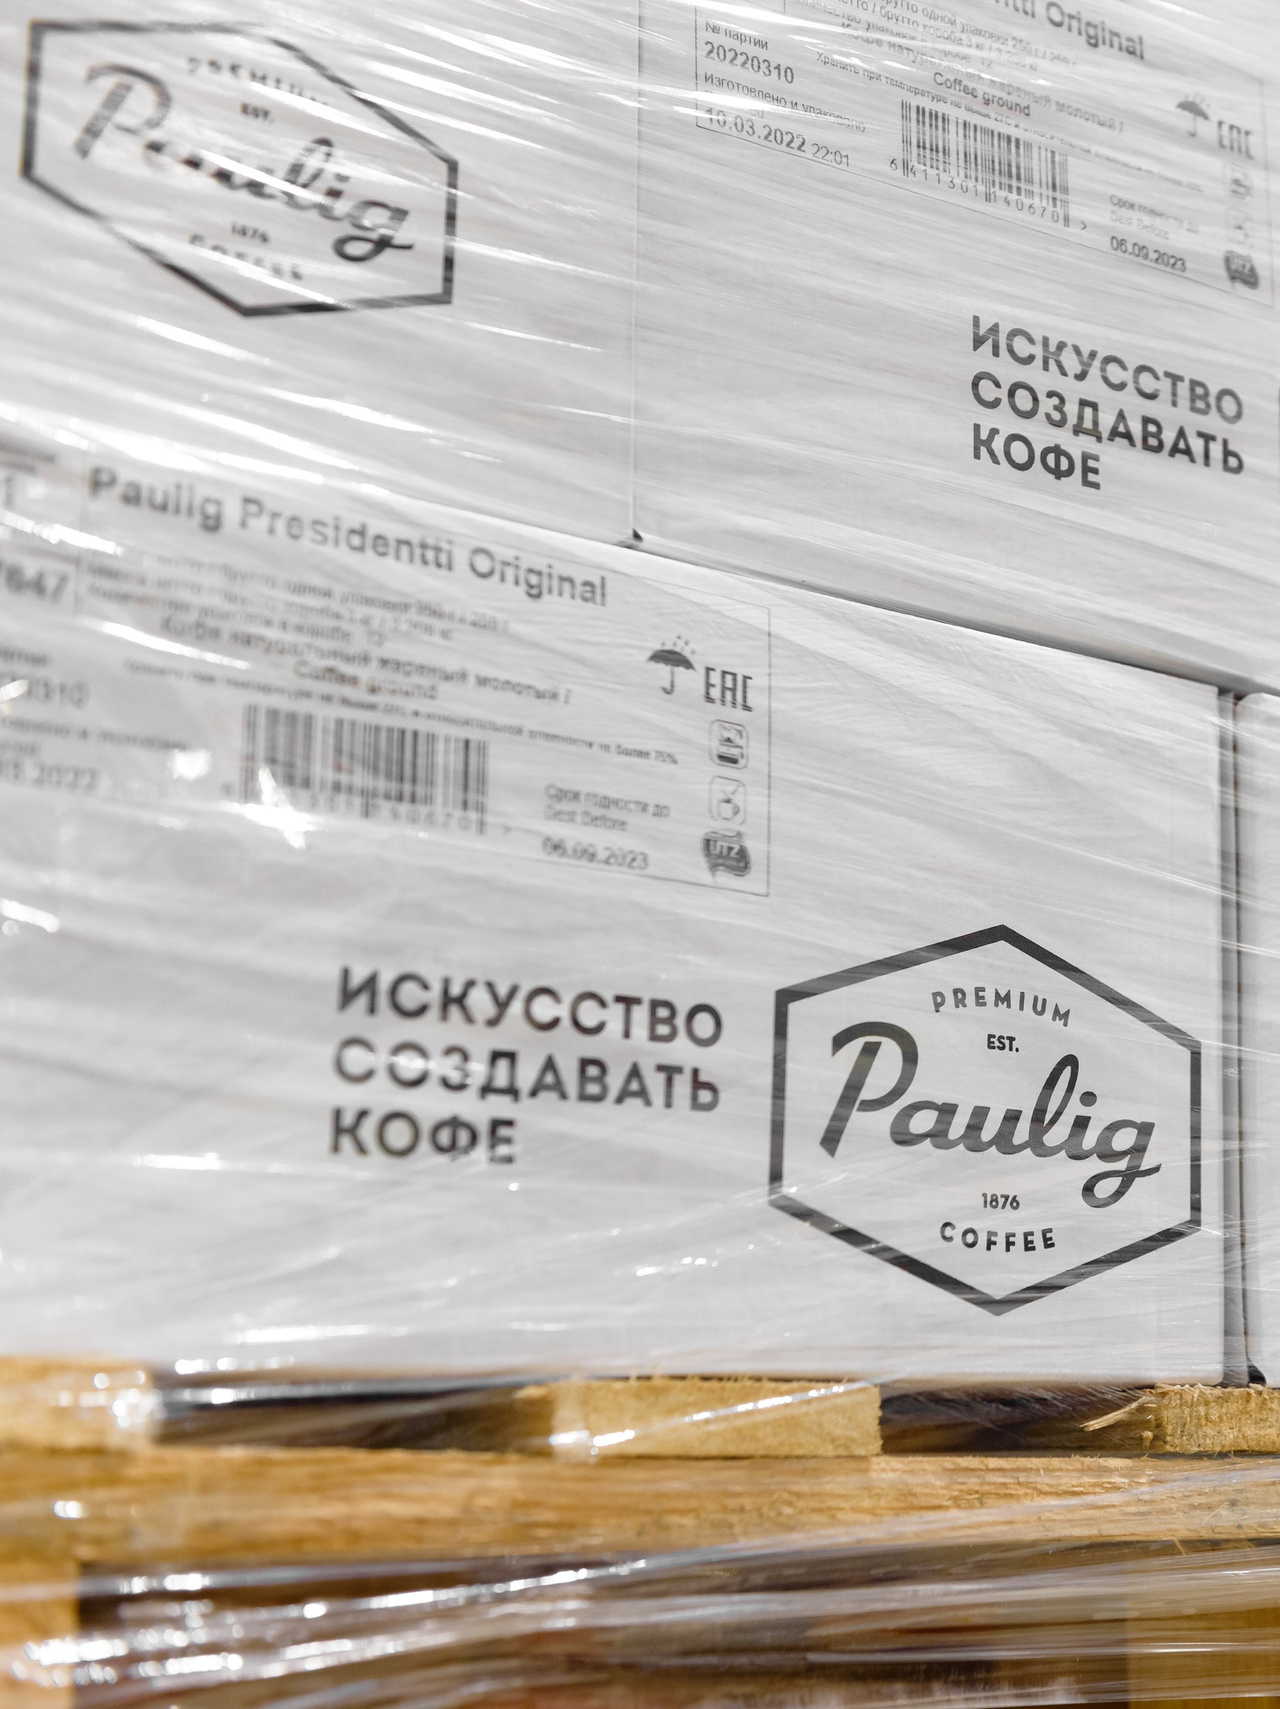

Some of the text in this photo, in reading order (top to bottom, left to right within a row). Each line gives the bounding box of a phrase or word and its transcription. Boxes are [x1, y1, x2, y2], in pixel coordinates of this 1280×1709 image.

[724, 28, 769, 51] партии
[880, 5, 920, 29] брутто
[922, 7, 957, 27] одной
[1046, 1, 1145, 60] Original
[704, 41, 796, 85] 20220310
[816, 51, 860, 75] Хранить
[862, 69, 883, 82] при
[884, 75, 949, 105] температуре
[704, 72, 788, 107] Изготовлено
[933, 72, 1031, 117] Coffee ground
[704, 106, 851, 168] 10.03.2022 22:01
[75, 62, 415, 262] Paulig
[1110, 235, 1188, 274] 06.09.2023
[972, 314, 1243, 424] ИСКУССТВО
[970, 370, 1245, 475] СОЗДАВАТЬ
[972, 422, 1102, 491] КОФЕ
[88, 465, 609, 607] Paulig Presidentti Original
[541, 836, 650, 872] 06.09.2023
[335, 964, 724, 1049] ИСКУССТВО
[931, 986, 1071, 1028] PREMIUM
[987, 1033, 1019, 1053] EST.
[332, 1037, 722, 1114] СОЗДАВАТЬ
[329, 1106, 517, 1165] КОФЕ
[819, 1021, 1162, 1209] Paulig
[981, 1192, 1020, 1211] 1876
[940, 1221, 1056, 1253] COFFEE
